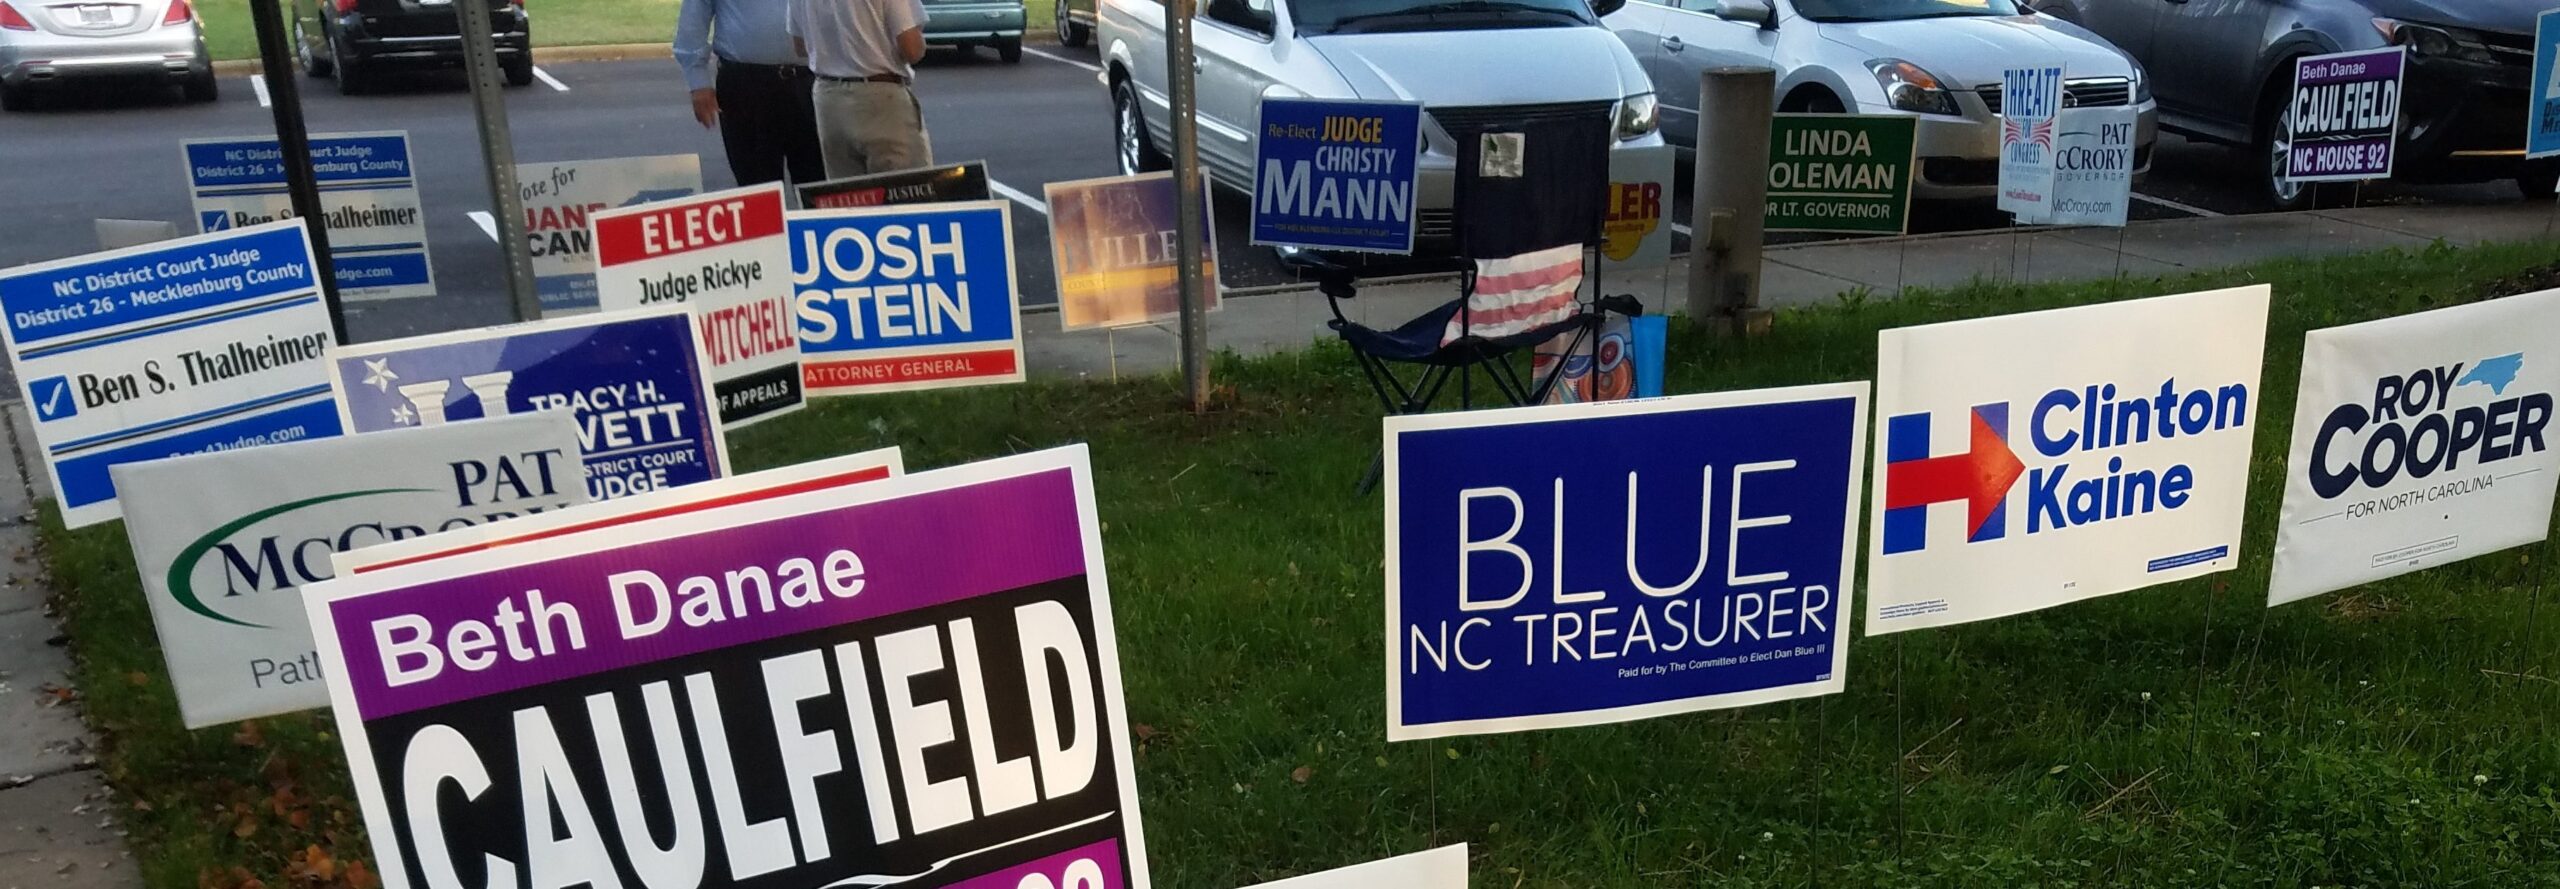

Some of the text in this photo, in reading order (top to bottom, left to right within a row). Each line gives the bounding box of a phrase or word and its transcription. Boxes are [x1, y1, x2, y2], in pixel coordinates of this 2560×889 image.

[2302, 61, 2366, 79] Beth Danae
[2004, 67, 2061, 117] THREATT
[2295, 79, 2396, 134] CAULFIELD
[1268, 116, 1383, 144] Re-Elect JUDGE
[1785, 129, 1872, 157] LINDA
[2101, 123, 2131, 145] PAT
[197, 165, 245, 178] District
[249, 163, 264, 175] 26
[360, 158, 404, 172] County
[247, 149, 282, 160] Distri
[335, 145, 372, 159] Judge
[1315, 145, 1397, 174] CHRISTY
[2010, 142, 2041, 164] CONGRESS
[2056, 146, 2128, 171] cCRORY
[2293, 143, 2386, 173] NC HOUSE 92
[519, 166, 576, 201] ote for
[887, 183, 936, 200] JUSTICE
[1260, 158, 1409, 222] MANN
[1769, 162, 1896, 190] OLEMAN
[2057, 172, 2125, 182] GOVERNOR
[641, 200, 745, 255] ELECT
[1782, 202, 1799, 217] LT.
[1803, 202, 1891, 219] GOVERNOR
[792, 221, 966, 285] JOSH
[53, 248, 261, 297] NC District Court Judge
[638, 260, 762, 305] Judge Rickye
[14, 304, 87, 330] District
[91, 299, 115, 316] 26
[131, 274, 243, 307] Mecklenburg
[245, 262, 304, 286] County
[797, 281, 973, 343] STEIN
[78, 331, 328, 409] Ben S. Thalheimer
[805, 357, 975, 383] ATTORNEY GENERAL
[635, 379, 666, 403] H.
[732, 379, 788, 410] APPEALS
[2372, 361, 2464, 424] ROY
[2030, 377, 2248, 458] Clinton
[2308, 392, 2554, 499] COOPER
[447, 448, 563, 508] PAT
[584, 448, 696, 479] STRICT COURT
[586, 468, 670, 501] UDGE
[2026, 456, 2193, 535] Kaine
[2346, 474, 2494, 521] FOR NORTH CAROLINA
[1458, 459, 1797, 612] BLUE
[371, 589, 587, 688] Beth
[608, 548, 867, 642] Danae
[1411, 585, 1829, 674] NC TREASURER
[1618, 667, 1639, 679] Paid
[1640, 665, 1654, 676] for
[1655, 663, 1668, 676] by
[1670, 662, 1686, 672] The
[1689, 656, 1737, 669] Committee
[1739, 654, 1749, 664] to
[1750, 651, 1773, 662] Elect
[1774, 649, 1793, 659] Dan
[1794, 646, 1816, 657] Blue
[401, 599, 1100, 889] CAULFIELD
